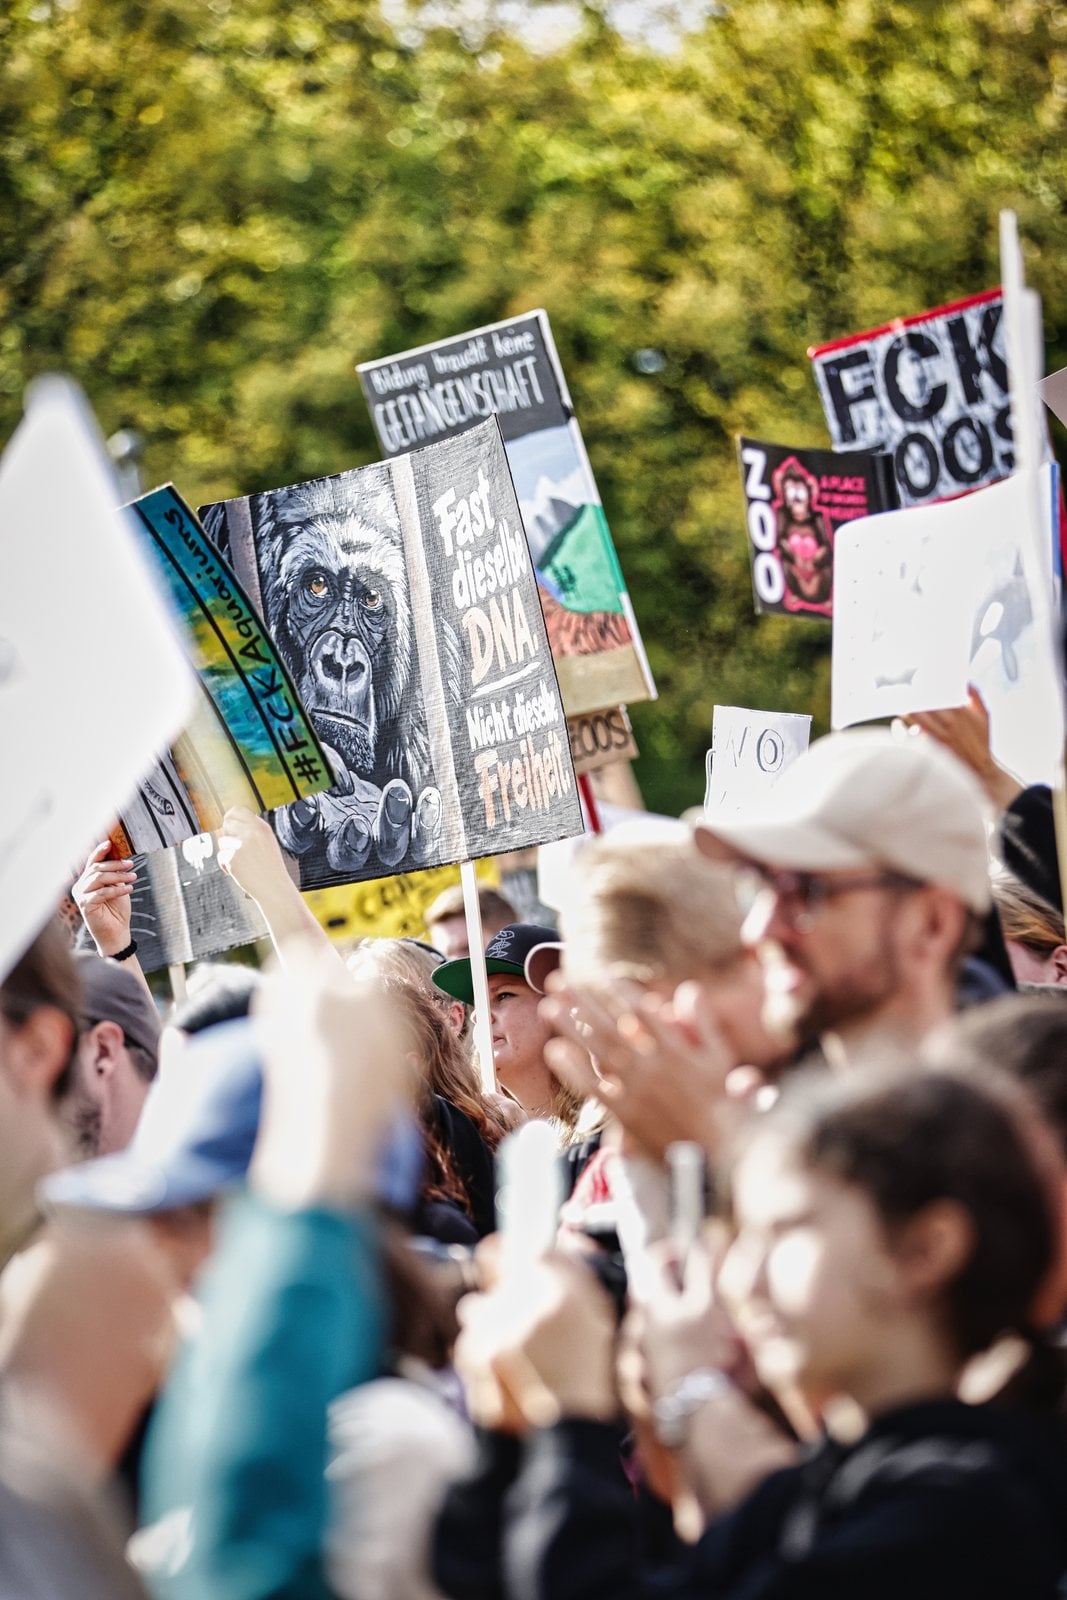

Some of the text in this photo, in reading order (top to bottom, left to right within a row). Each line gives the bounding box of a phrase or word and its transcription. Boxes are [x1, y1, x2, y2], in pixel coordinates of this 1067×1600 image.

[370, 328, 536, 394] Bildung braucht keine
[374, 355, 545, 452] GEFANGENSCHAFT
[822, 305, 1010, 443] FCK
[432, 467, 495, 557] Fast
[742, 448, 785, 604] ZOO
[453, 518, 527, 609] dieselbe
[163, 507, 322, 785] #FCK Aquariums
[466, 700, 513, 751] Nicht
